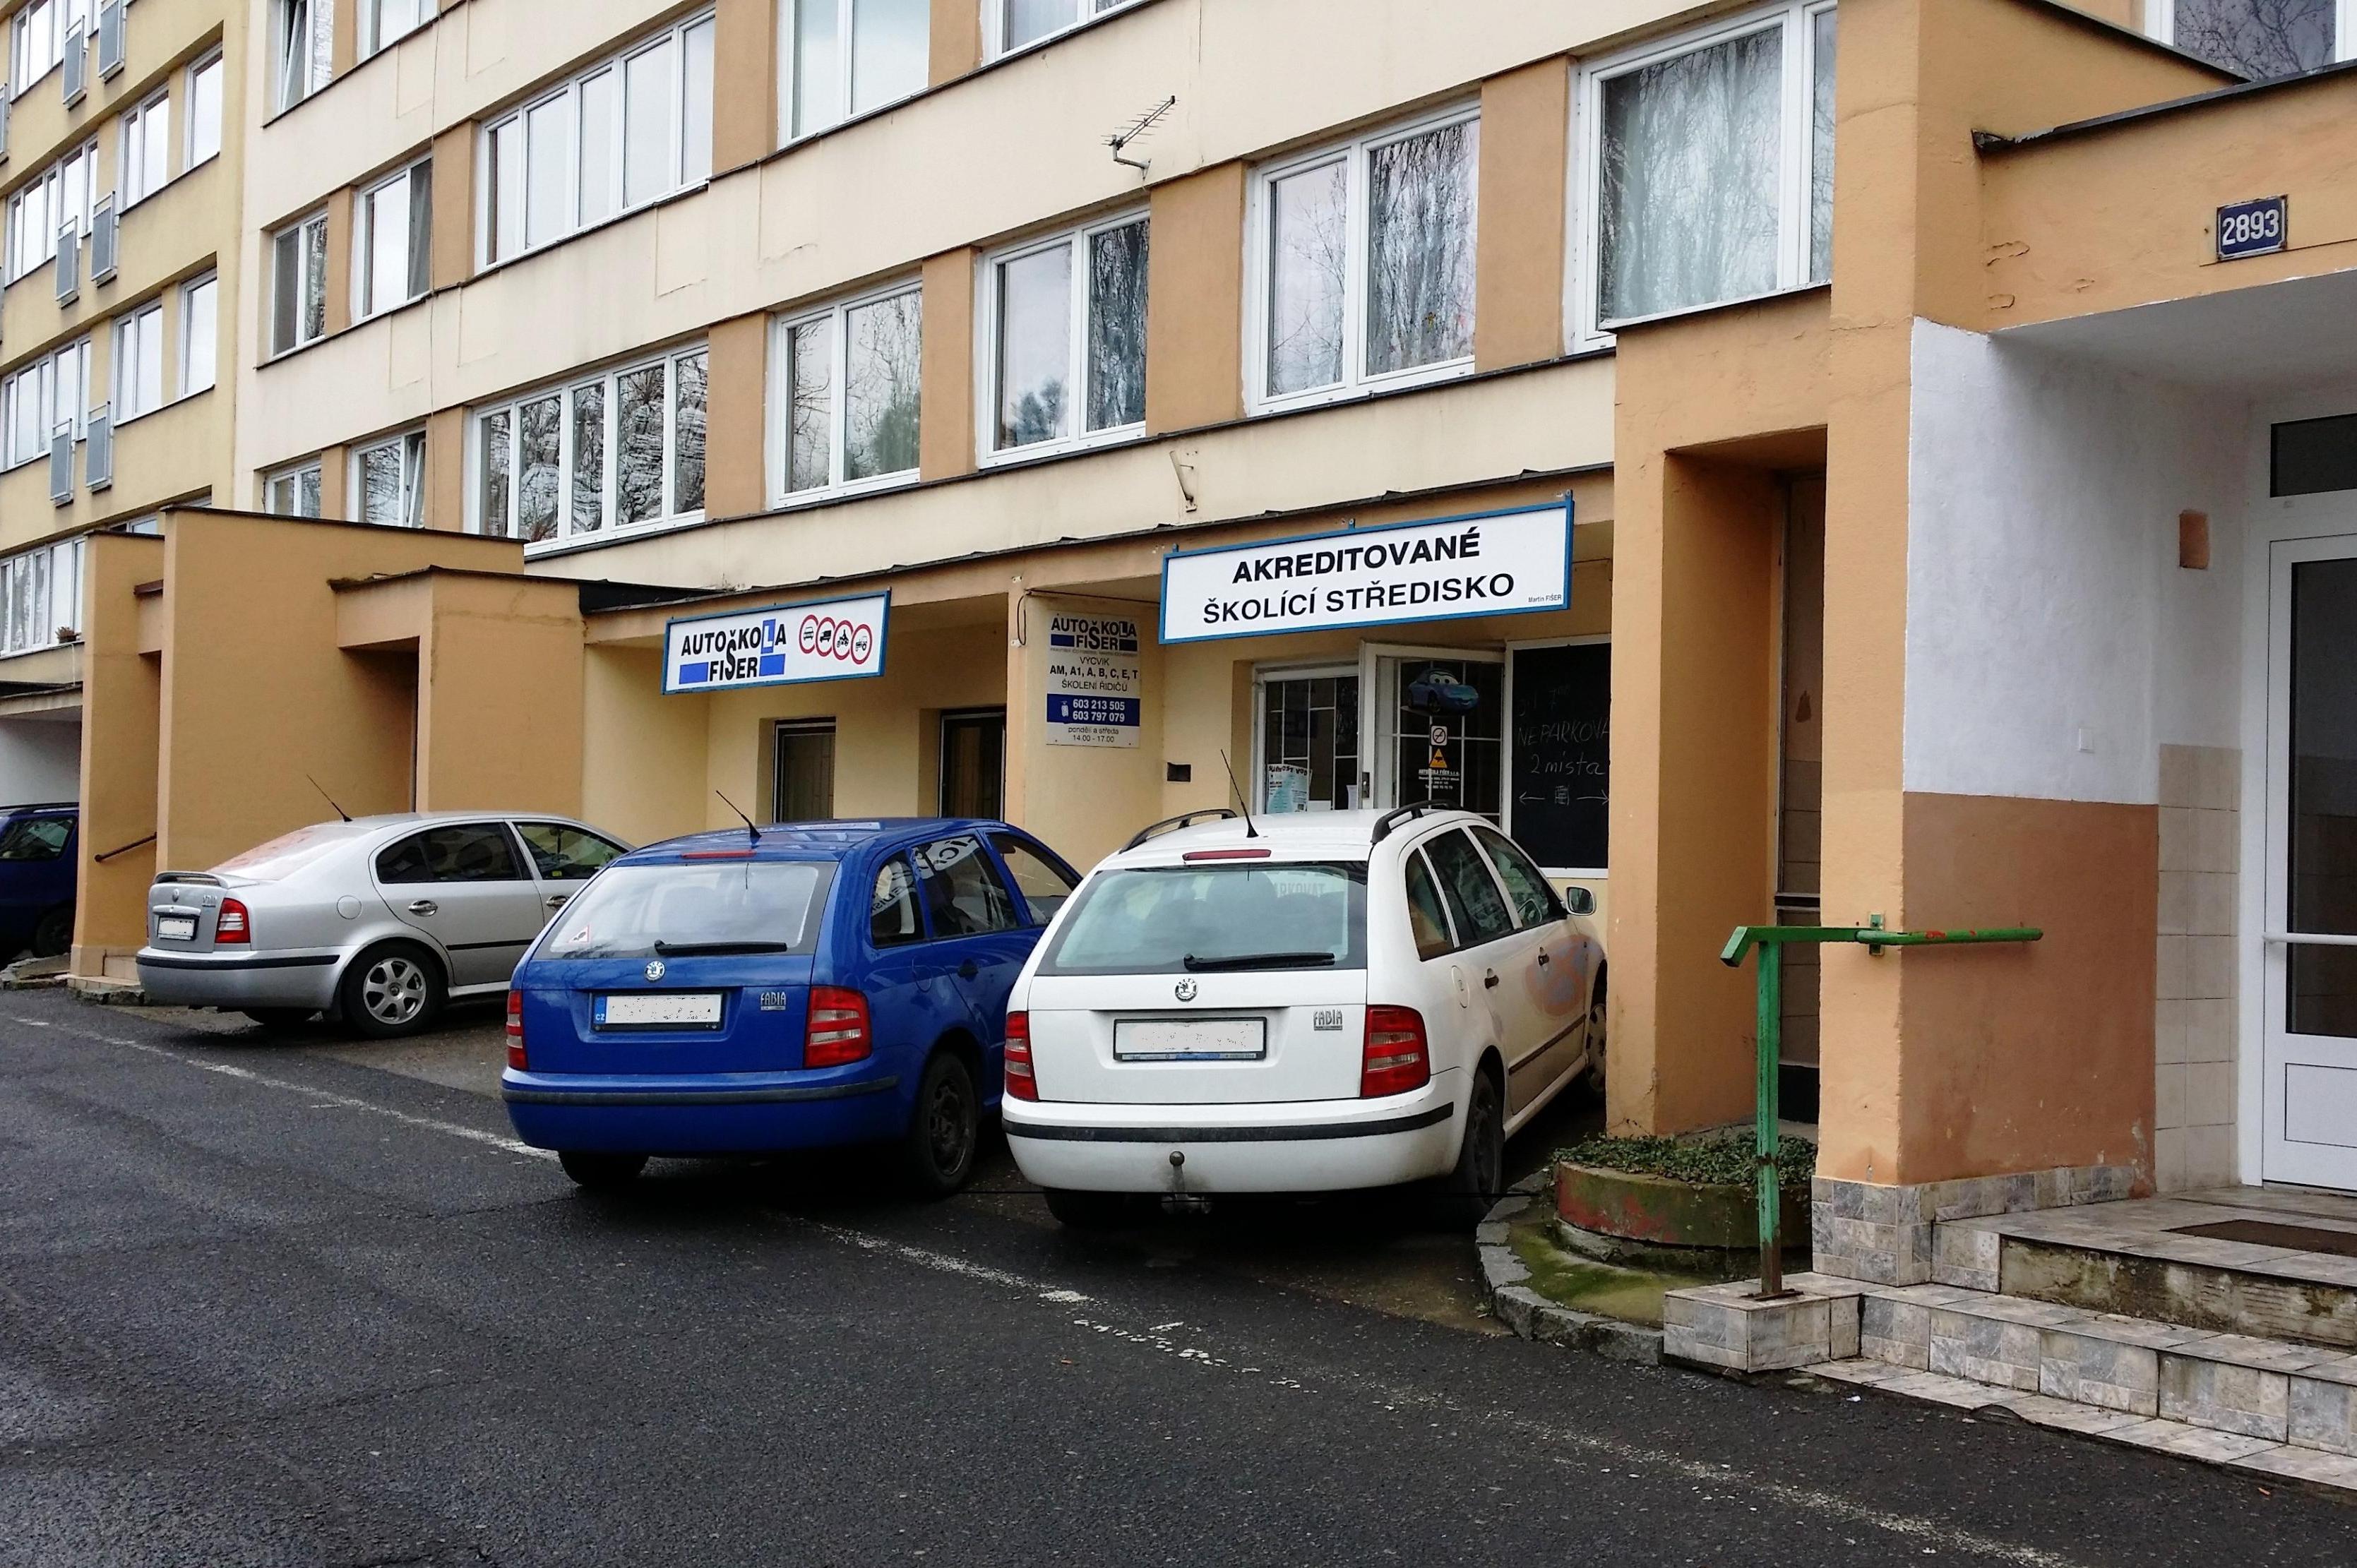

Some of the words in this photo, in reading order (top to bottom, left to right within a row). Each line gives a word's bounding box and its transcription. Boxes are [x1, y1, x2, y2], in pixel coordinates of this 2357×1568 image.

[2221, 209, 2279, 246] 2893
[1232, 526, 1481, 584] AKREDITOVANÉ
[1203, 585, 1318, 624] ŠKOLÍCÍ
[1326, 573, 1515, 612] STŘEDISKO
[1051, 617, 1137, 638] AUTOŠKOLA
[681, 621, 787, 657] AUTOŠKOLA
[1049, 665, 1068, 676] AM,
[1070, 666, 1084, 677] A1,
[1099, 668, 1108, 678] B,
[1122, 669, 1130, 680] E,
[1133, 670, 1138, 678] T
[1073, 699, 1089, 709] 603
[1091, 700, 1107, 710] 213
[1109, 701, 1125, 711] 505
[1073, 710, 1089, 720] 603
[1091, 712, 1107, 722] 797
[1109, 712, 1125, 722] 079
[760, 991, 787, 1006] FABIA
[595, 1012, 605, 1022] CZ
[1313, 1009, 1343, 1026] FABIA
